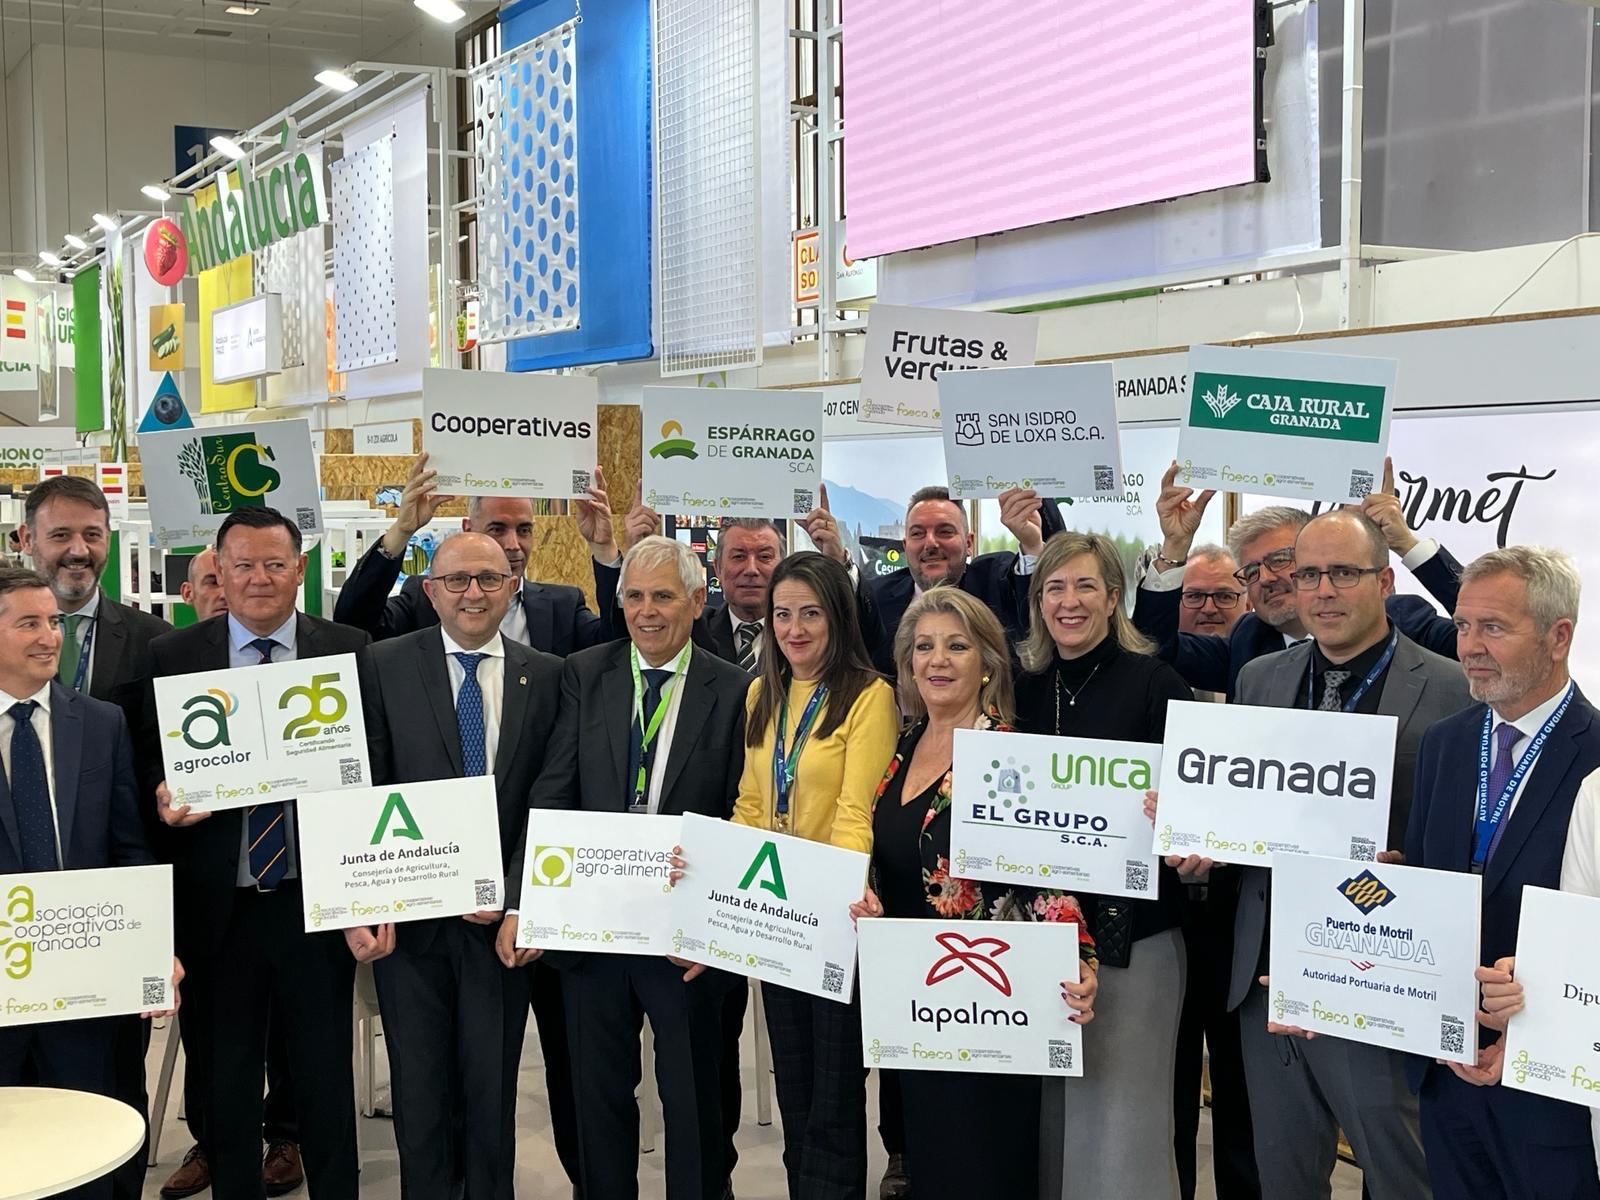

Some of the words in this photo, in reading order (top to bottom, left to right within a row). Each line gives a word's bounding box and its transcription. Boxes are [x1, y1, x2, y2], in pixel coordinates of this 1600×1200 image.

[182, 118, 328, 278] Andalucía
[892, 330, 984, 359] Frutas
[990, 341, 1008, 361] &
[884, 355, 992, 382] Verd
[1114, 375, 1178, 398] RANADA
[1246, 393, 1295, 412] CAJA
[1299, 397, 1370, 419] RURAL
[431, 412, 591, 439] Cooperativas
[988, 413, 1020, 427] SAN
[1025, 410, 1077, 426] ISIDRO
[1269, 413, 1342, 431] GRANADA
[707, 424, 815, 443] ESPÁRRAGO
[990, 430, 1010, 444] DE
[1016, 427, 1056, 443] LOXA
[1062, 426, 1105, 441] S.C.A.
[0, 448, 30, 460] ION
[707, 444, 728, 458] DE
[732, 445, 815, 461] GRANADA
[789, 461, 815, 474] SCA
[1221, 465, 1259, 484] faeca
[464, 473, 498, 488] faeca
[323, 723, 351, 736] años
[173, 749, 252, 774] agrocolor
[1513, 732, 1547, 780] PORTUARIA
[1177, 747, 1377, 800] Granada
[1479, 771, 1488, 822] AUTORIDAD
[1505, 780, 1518, 793] DE
[972, 803, 1004, 822] EL
[1013, 808, 1108, 832] GRUPO
[1490, 792, 1511, 825] MOTRIL
[1060, 834, 1108, 848] S.C.A.
[1205, 831, 1247, 852] faeca
[340, 852, 376, 866] Junta
[380, 850, 395, 861] de
[397, 841, 460, 860] Andalucía
[576, 847, 673, 863] cooperativas
[995, 854, 1034, 874] faeca
[345, 880, 370, 889] Pesca,
[371, 877, 391, 888] Agua
[398, 871, 438, 883] Desarrollo
[439, 869, 459, 878] Rural
[352, 866, 393, 878] Consejería
[394, 865, 405, 874] de
[405, 862, 450, 874] Agricultura,
[575, 862, 677, 877] agro-aliment
[707, 889, 741, 907] Junta
[743, 898, 758, 912] de
[760, 903, 819, 928] Andalucía
[126, 919, 142, 930] de
[707, 917, 730, 932] Pesca,
[731, 924, 750, 937] Agua
[755, 929, 793, 946] Desarrollo
[793, 939, 813, 951] Rural
[716, 909, 753, 925] Consejería
[754, 919, 763, 929] de
[765, 921, 806, 940] Agricultura,
[1326, 917, 1360, 933] Puerto
[1363, 923, 1377, 935] de
[1379, 924, 1413, 941] Motril
[1305, 921, 1436, 966] GRANADA
[1302, 967, 1347, 985] Autoridad
[1349, 976, 1391, 994] Portuaria
[1393, 984, 1405, 996] de
[1407, 986, 1438, 1001] Motril
[6, 997, 48, 1015] faeca
[911, 1000, 1028, 1032] lapalma
[1312, 999, 1350, 1025] faeca
[912, 1042, 953, 1060] faeca
